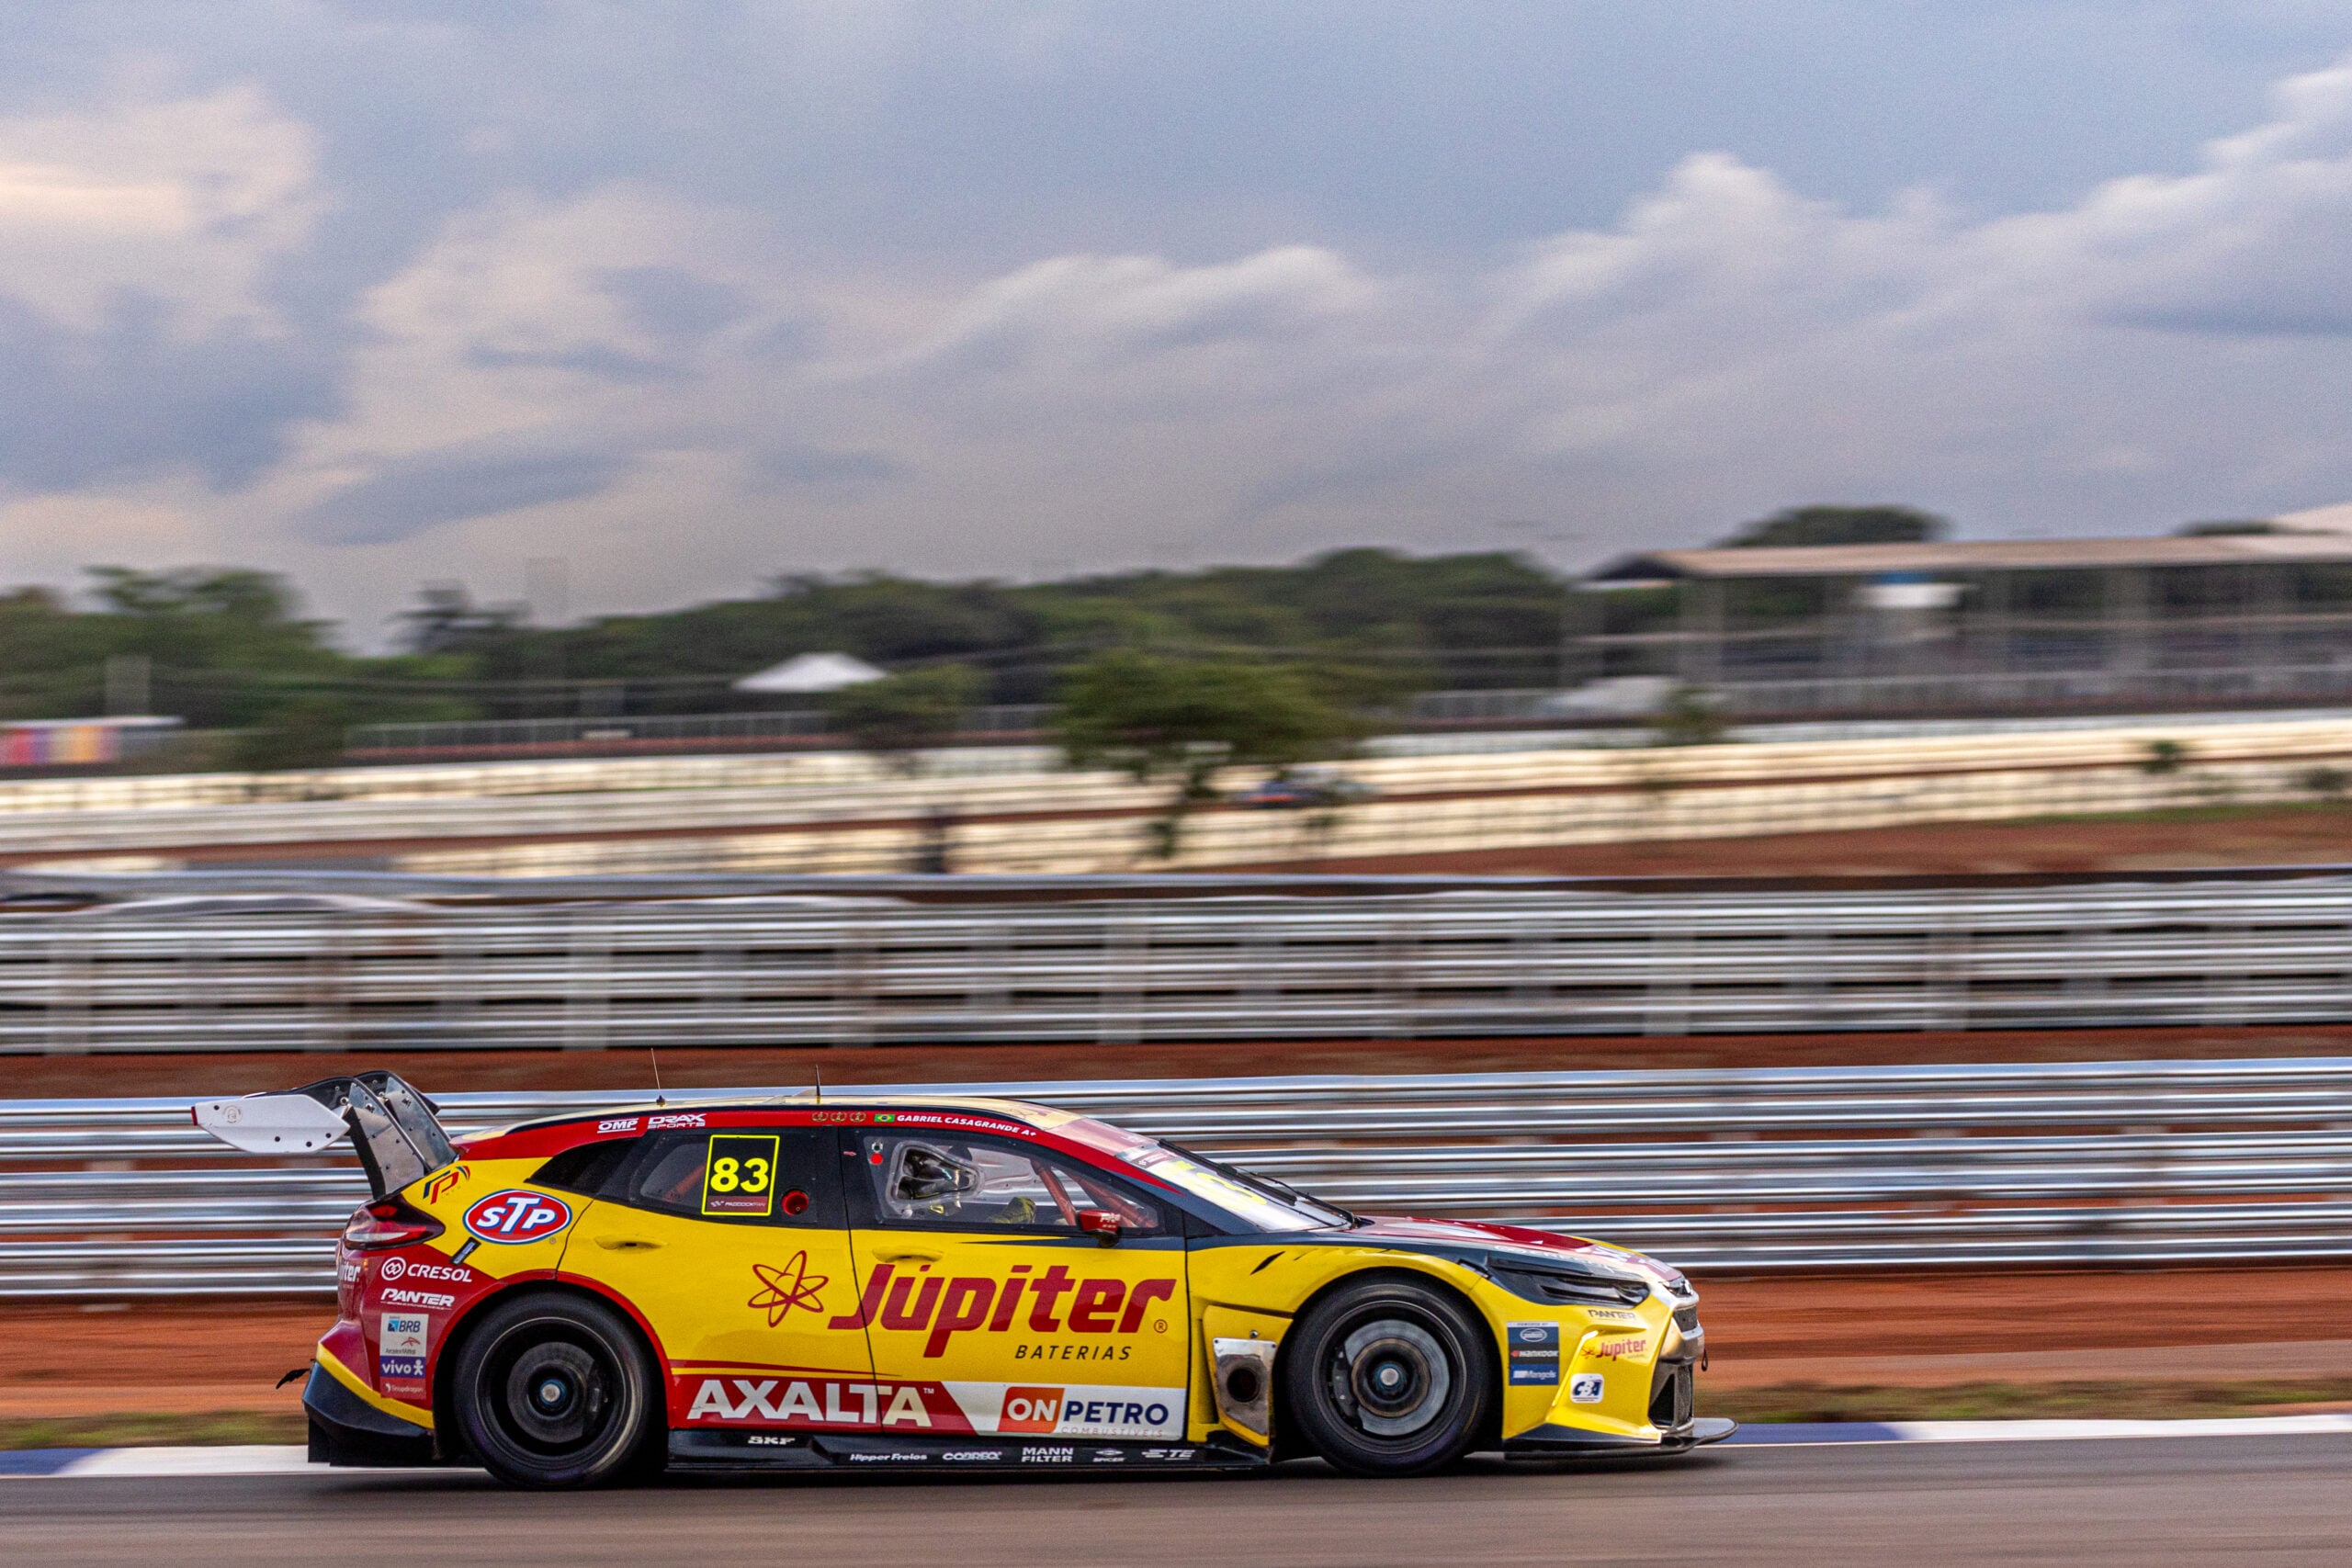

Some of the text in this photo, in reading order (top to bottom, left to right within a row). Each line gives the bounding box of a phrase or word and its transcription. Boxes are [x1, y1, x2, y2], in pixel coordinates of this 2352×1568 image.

[598, 1119, 638, 1132] OMP
[648, 1113, 707, 1123] DRAX
[897, 1114, 943, 1123] GABRIEL
[944, 1116, 1020, 1134] CASAGRANDE
[710, 1156, 769, 1192] 83
[476, 1197, 557, 1233] STP
[407, 1263, 473, 1283] CRESOL
[380, 1288, 456, 1307] PANTER
[827, 1263, 1177, 1358] Júpiter
[1588, 1309, 1636, 1320] PANTER
[399, 1320, 422, 1333] BRB
[1014, 1345, 1132, 1360] BATERIAS
[382, 1359, 412, 1374] vivo
[1572, 1379, 1603, 1396] CBA
[686, 1380, 933, 1427] AXALTA
[1007, 1397, 1170, 1426] ON PETRO
[748, 1435, 796, 1445] SKF
[849, 1453, 890, 1461] Hipper
[1023, 1447, 1074, 1455] MANN
